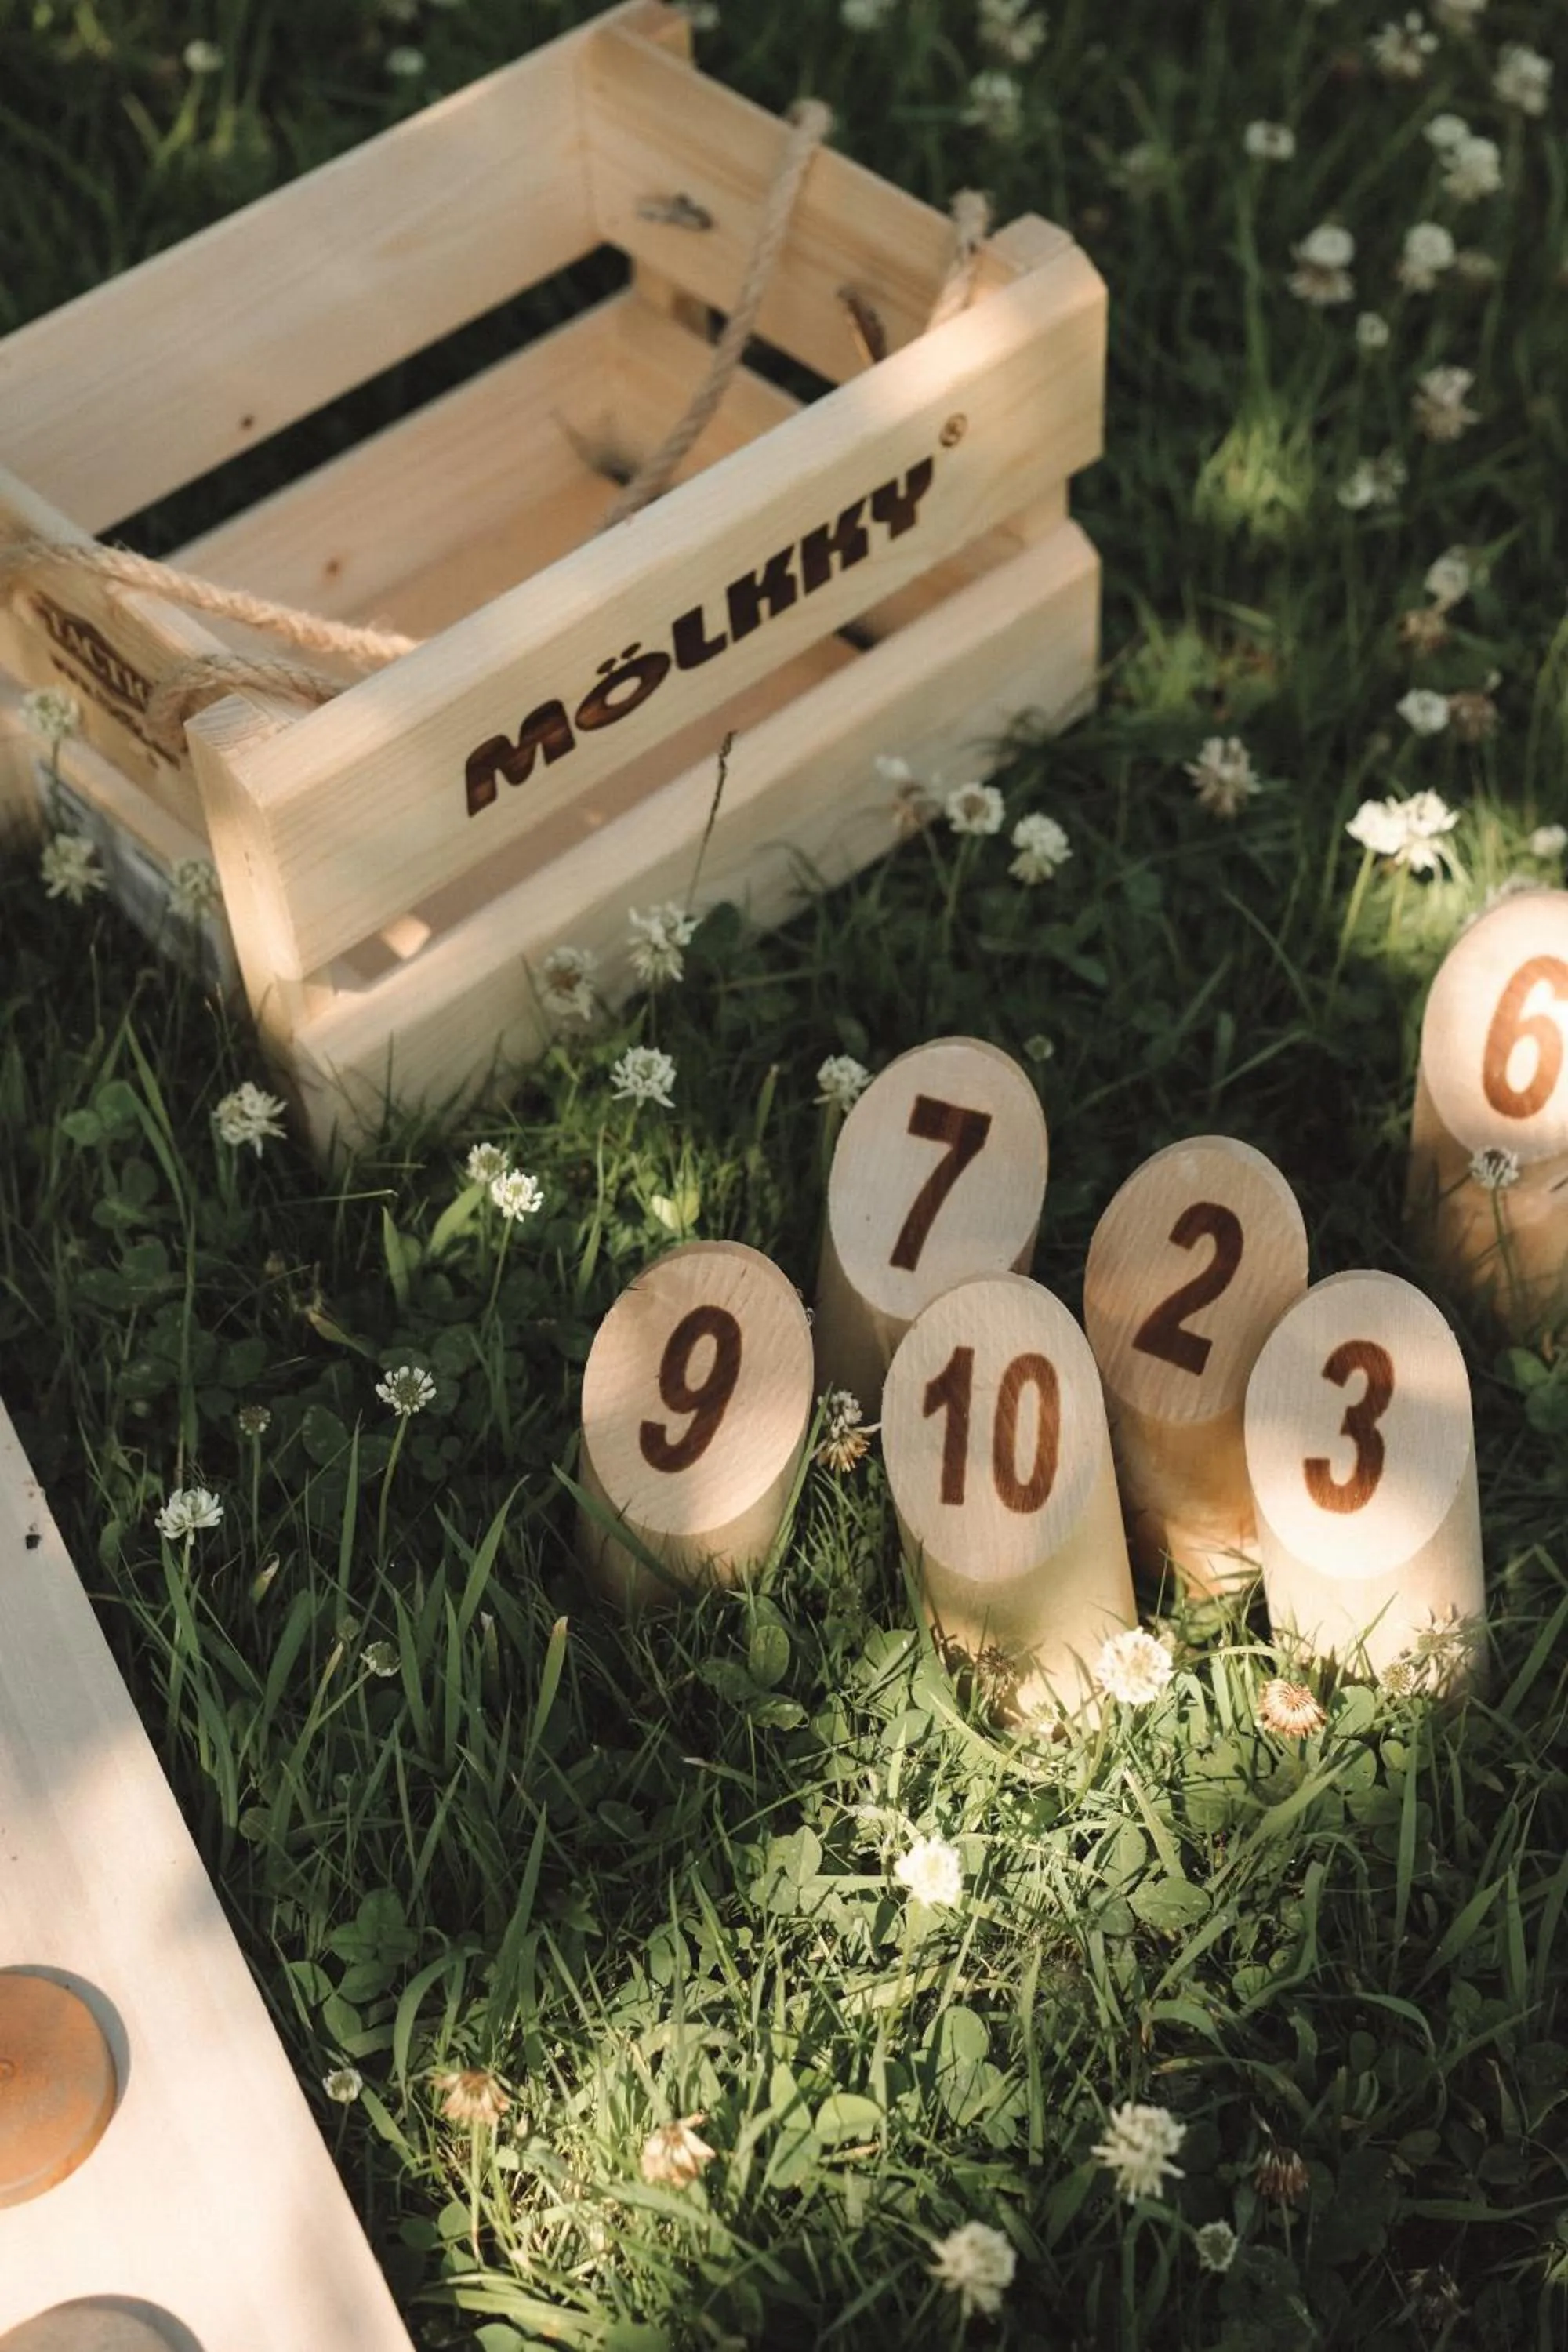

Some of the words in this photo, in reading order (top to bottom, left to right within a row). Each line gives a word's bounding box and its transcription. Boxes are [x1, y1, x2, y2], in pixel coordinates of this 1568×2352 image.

[1482, 955, 1568, 1120] 6
[890, 1094, 992, 1272] 7
[1131, 1201, 1244, 1376] 2
[639, 1305, 742, 1474] 9
[923, 1346, 1060, 1514] 10
[1303, 1339, 1394, 1514] 3
